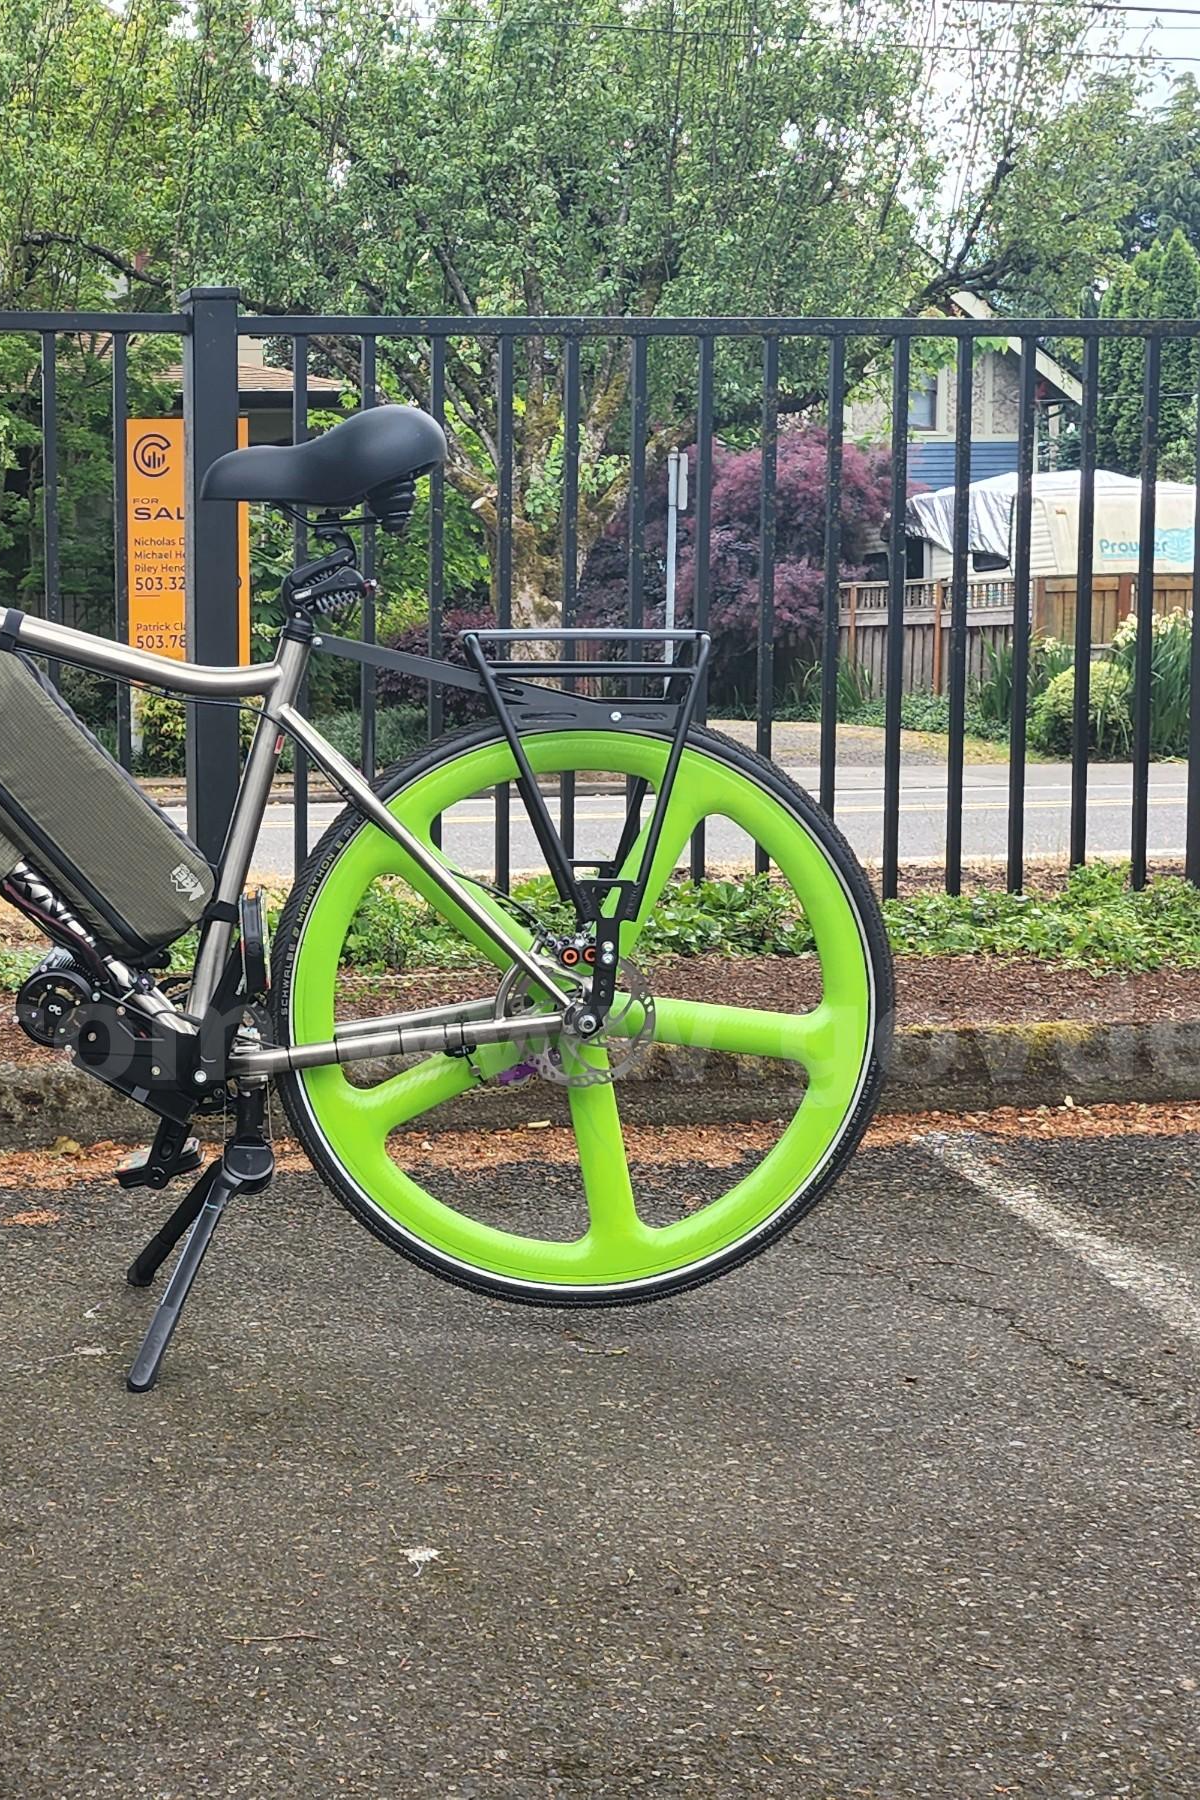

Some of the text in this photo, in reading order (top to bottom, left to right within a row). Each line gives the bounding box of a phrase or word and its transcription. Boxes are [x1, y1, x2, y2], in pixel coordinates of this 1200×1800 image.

[134, 507, 185, 520] SAL
[134, 537, 176, 546] Nicholas
[135, 551, 172, 559] Michael
[135, 564, 158, 574] Riley
[136, 623, 170, 631] Patrick
[281, 943, 296, 1016] SCHWALBE
[297, 853, 335, 924] MARATHON
[344, 814, 365, 838] PLU
